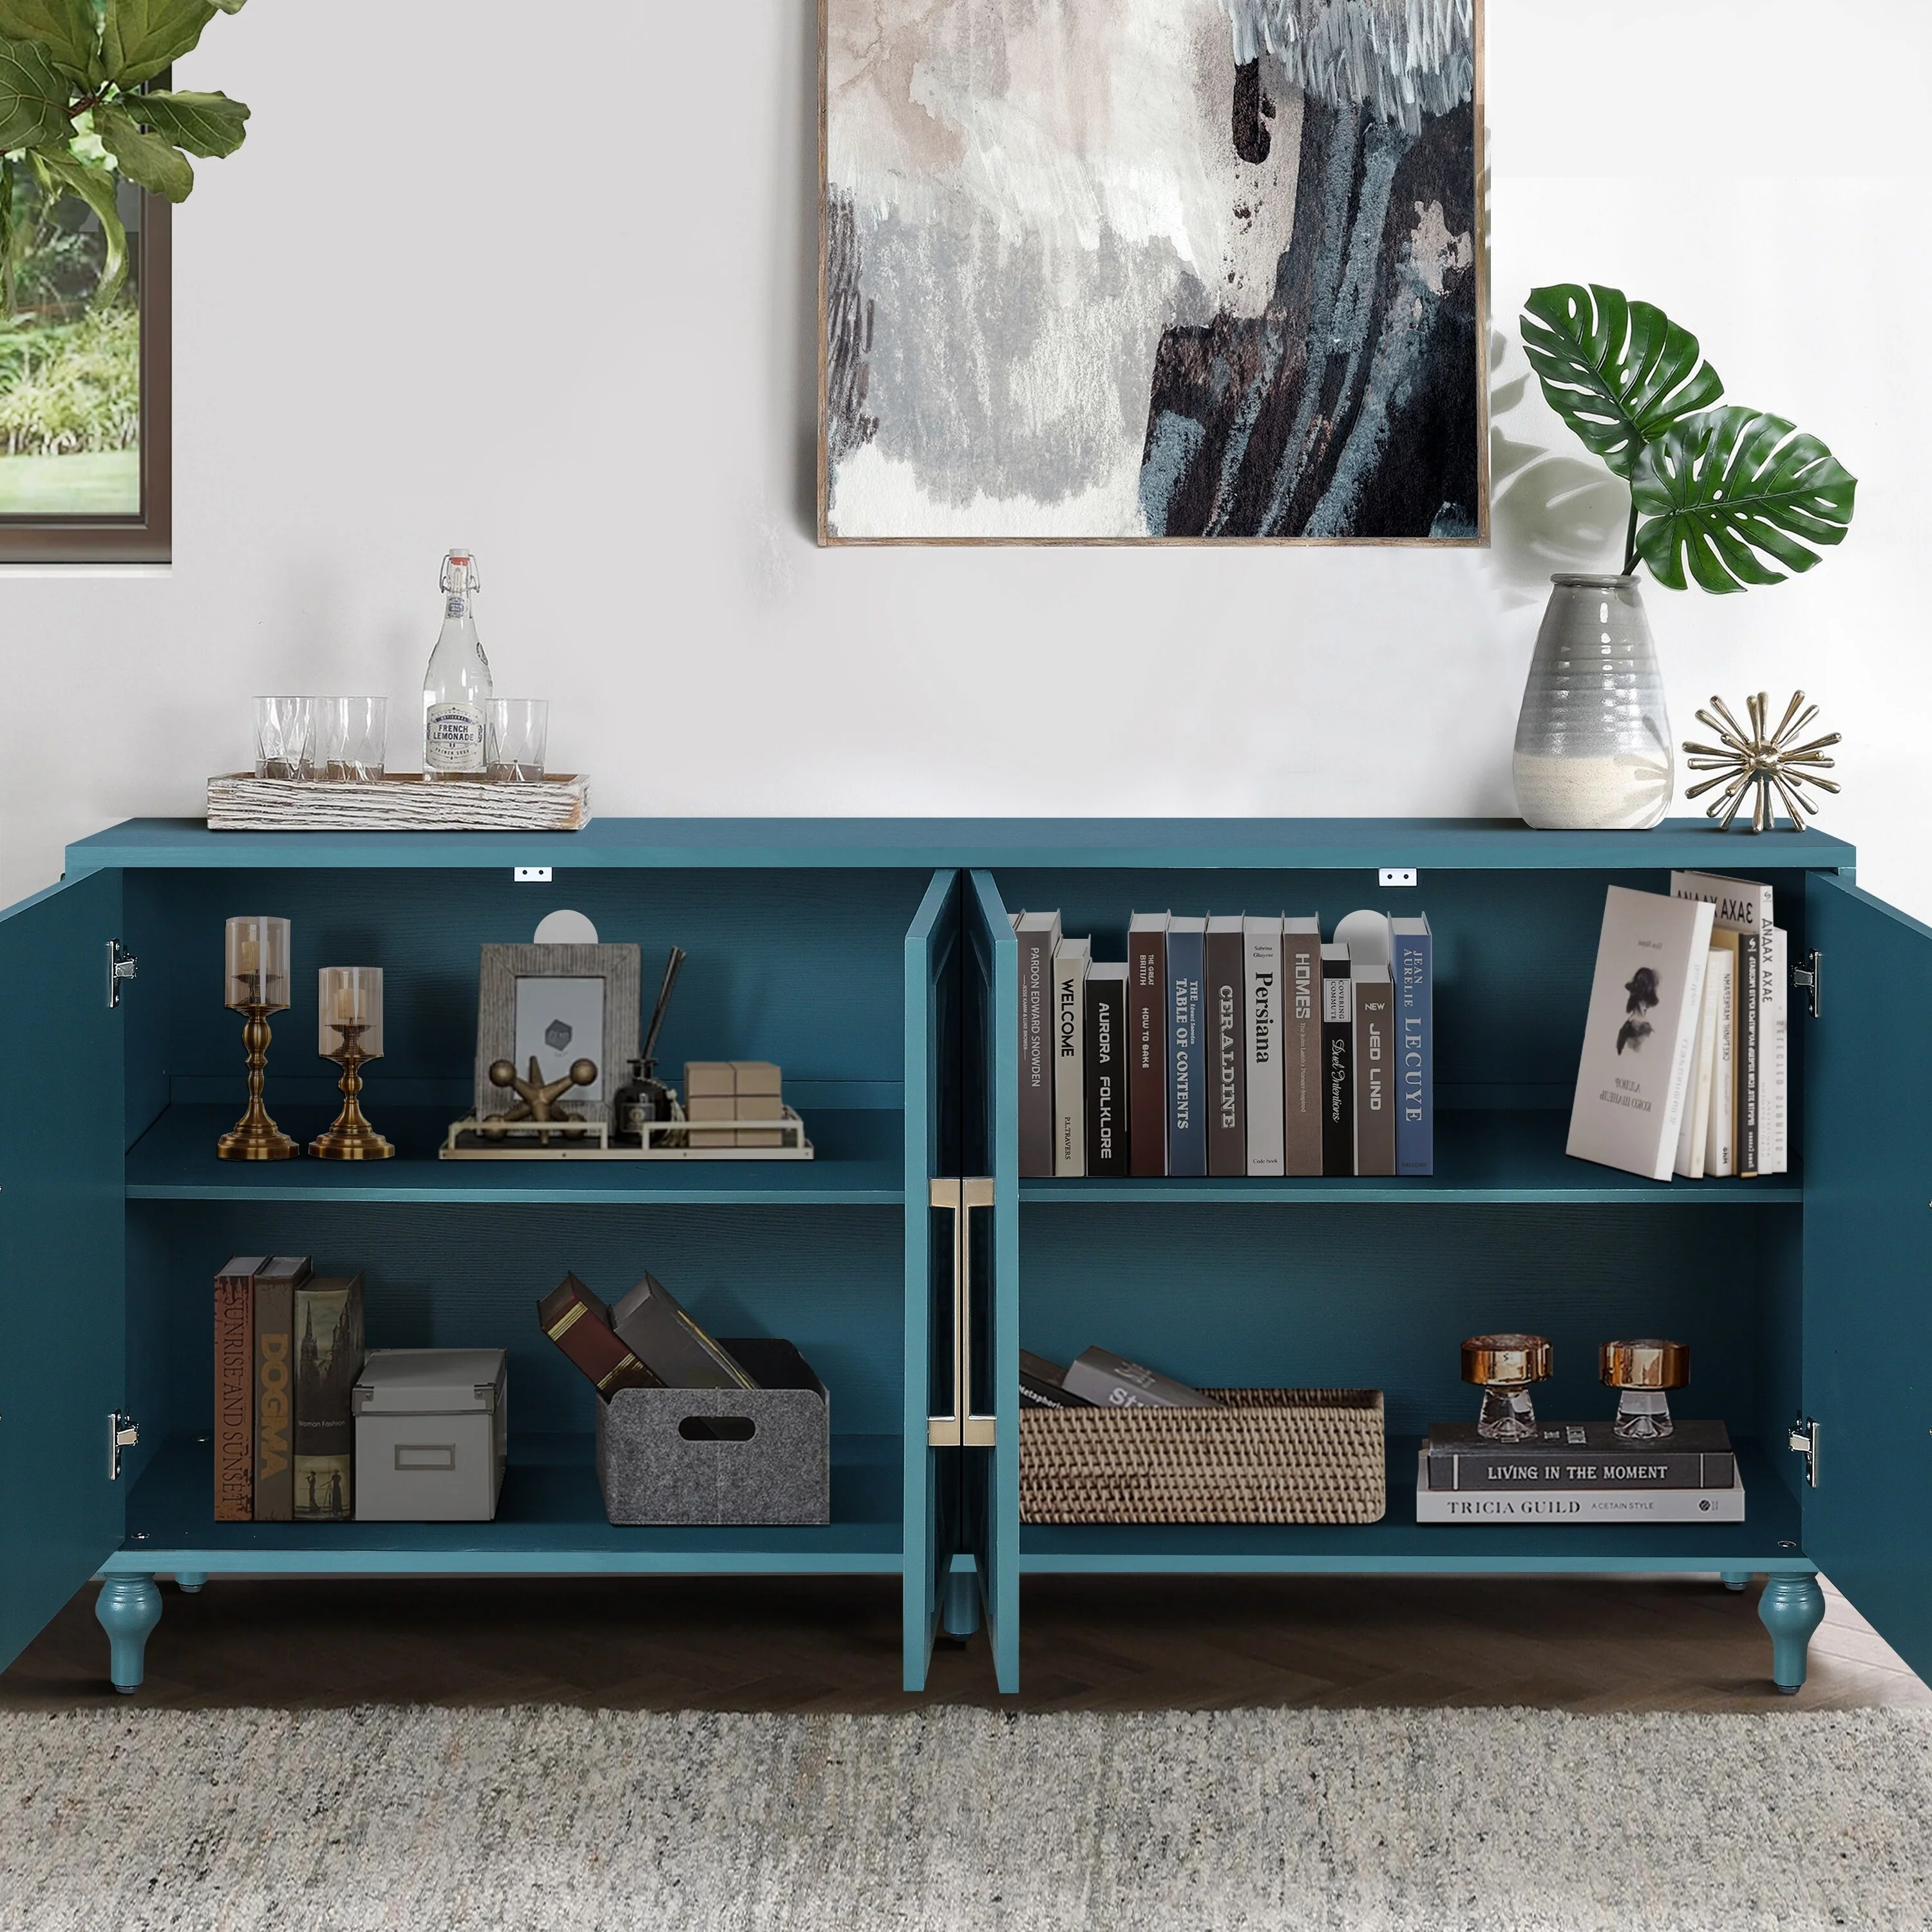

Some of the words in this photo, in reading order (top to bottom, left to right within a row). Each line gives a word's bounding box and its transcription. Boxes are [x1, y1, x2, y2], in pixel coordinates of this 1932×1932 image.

[433, 732, 474, 741] LEMONADE
[1030, 947, 1040, 988] PARDON
[1295, 953, 1311, 1019] HOMES
[1403, 949, 1413, 1007] AURELIE
[1413, 951, 1423, 984] JEAN
[1030, 990, 1040, 1034] EDWARD
[1061, 978, 1074, 1057] WELCOME
[1176, 978, 1188, 1023] TABLE
[1255, 971, 1273, 1064] Persiana
[1098, 1002, 1110, 1064] AURORA
[1142, 1031, 1149, 1042] TO
[1177, 1027, 1188, 1047] OF
[1332, 1039, 1346, 1070] Duel
[1369, 1023, 1381, 1061] JED
[1031, 1036, 1041, 1087] SNOWDEN
[1405, 1018, 1423, 1122] LECUYE
[1177, 1051, 1189, 1130] CONTENTS
[1370, 1068, 1381, 1110] LIND
[1100, 1076, 1112, 1159] FOLKLORE
[223, 1296, 243, 1378] SUNRISE
[223, 1383, 243, 1427] AND
[261, 1333, 289, 1481] DOGMA
[223, 1432, 243, 1504] SUNSET
[1488, 1466, 1538, 1479] LIVING
[1545, 1466, 1560, 1479] IN
[1566, 1466, 1597, 1479] THE
[1603, 1466, 1668, 1479] MOMENT
[1447, 1501, 1515, 1514] TRICIA
[1520, 1501, 1581, 1514] GUILD
